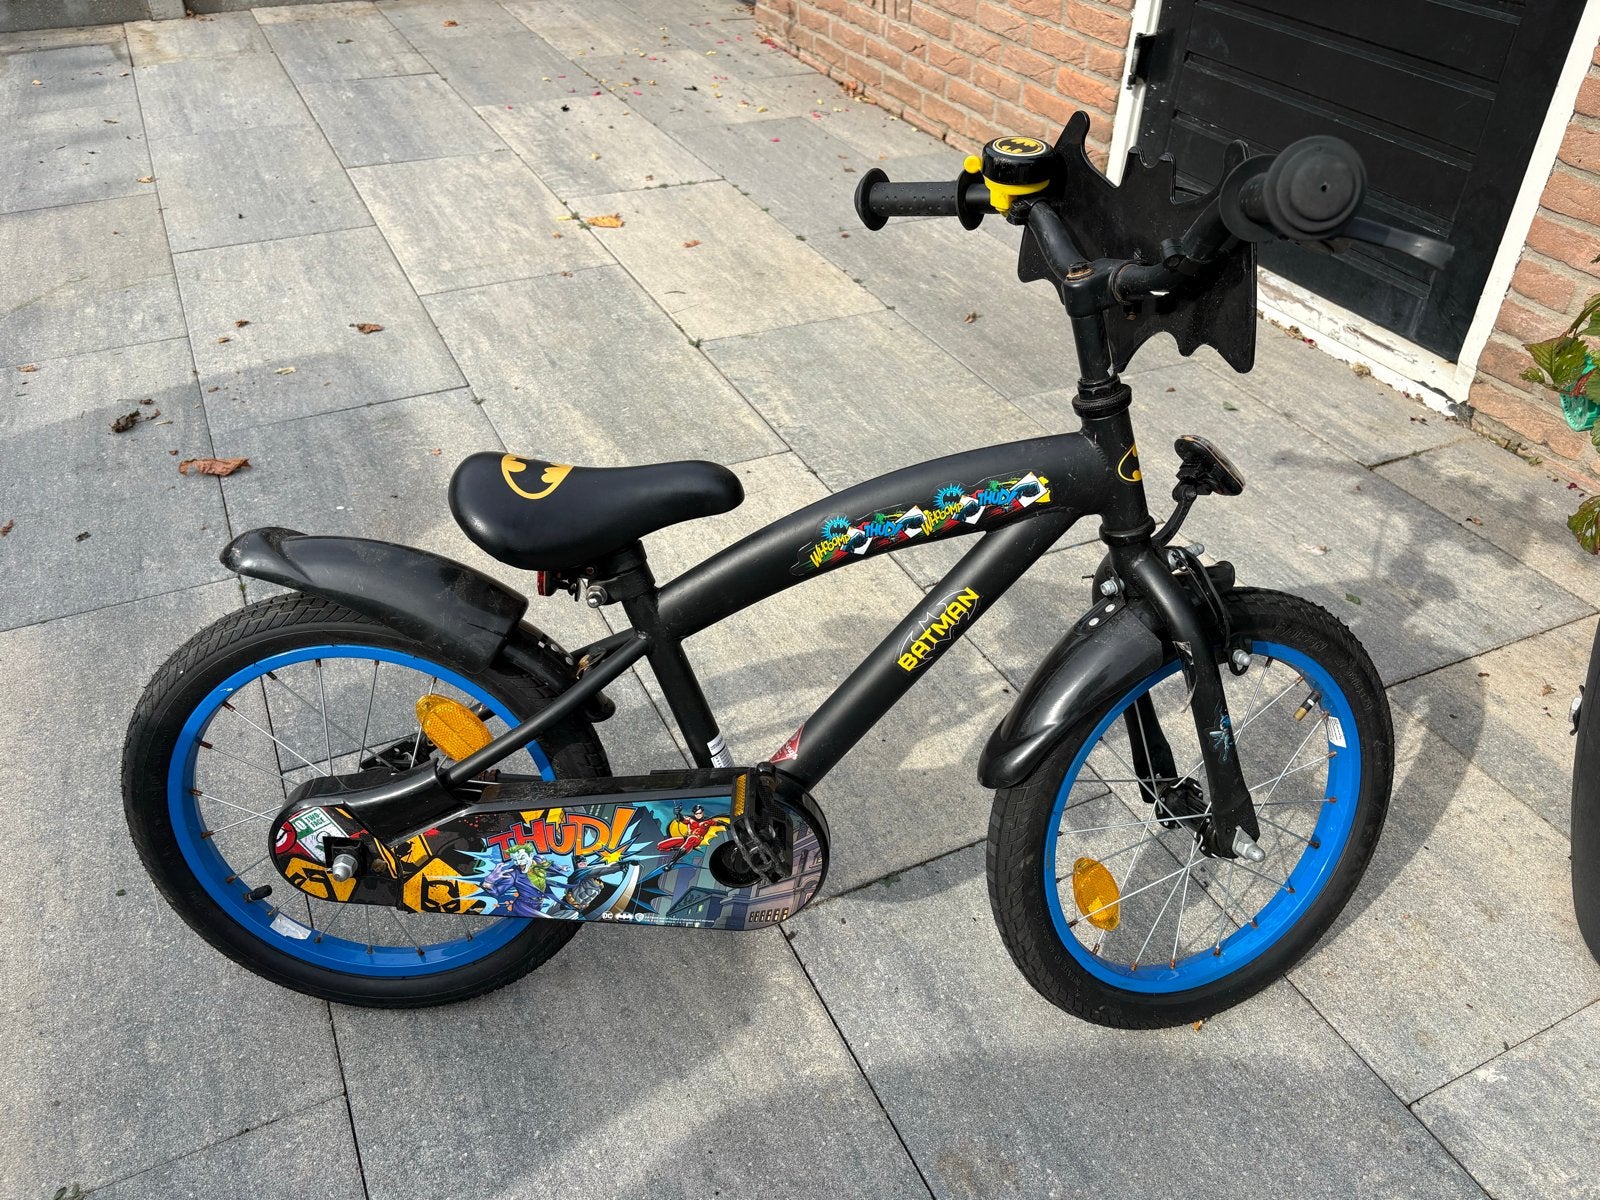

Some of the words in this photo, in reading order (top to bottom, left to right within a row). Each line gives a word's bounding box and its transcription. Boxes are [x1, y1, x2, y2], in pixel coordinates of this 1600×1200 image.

[897, 587, 979, 672] BATMAN
[310, 816, 325, 828] FACE
[487, 805, 637, 863] THUD!
[602, 911, 613, 920] DC
